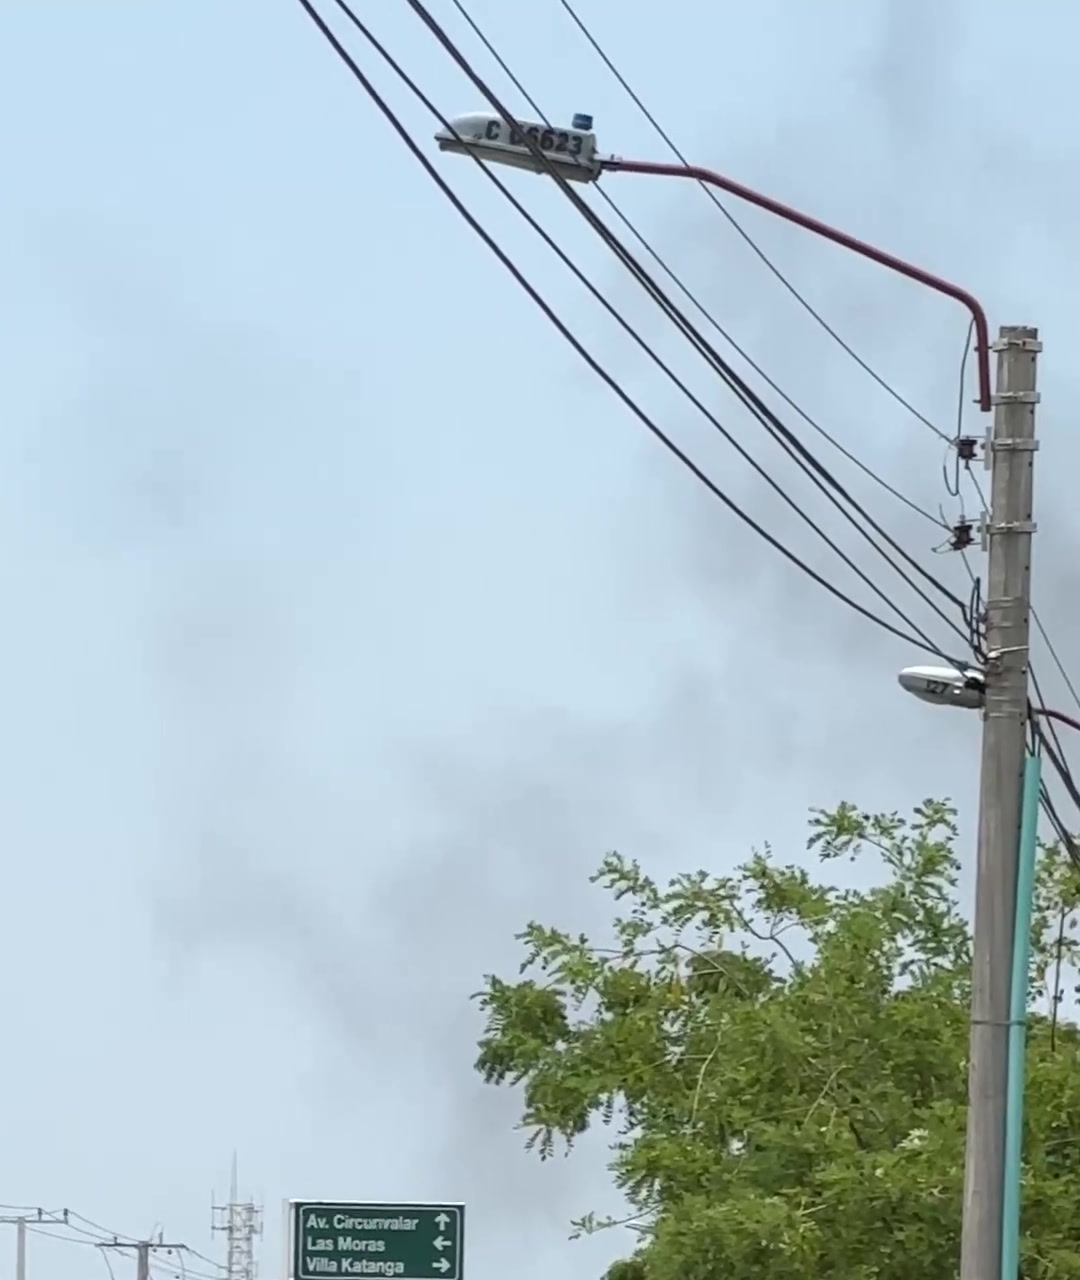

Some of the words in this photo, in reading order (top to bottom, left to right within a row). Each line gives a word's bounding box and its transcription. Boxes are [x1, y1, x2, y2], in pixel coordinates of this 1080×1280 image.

[306, 1213, 329, 1228] Av.
[307, 1235, 334, 1251] Las
[338, 1237, 386, 1252] Moras
[306, 1256, 337, 1272] Villa
[341, 1257, 405, 1276] Katanga
